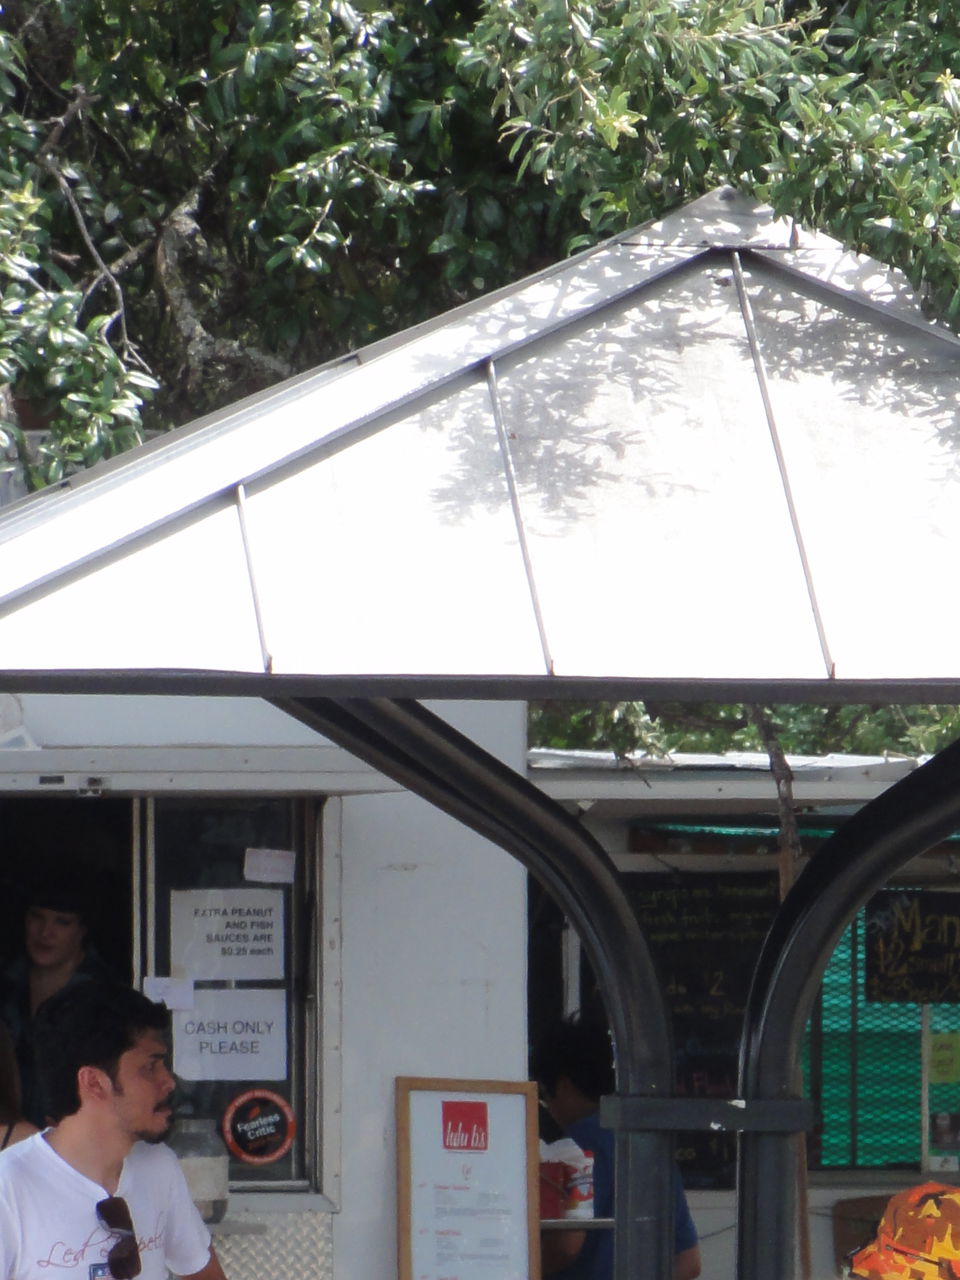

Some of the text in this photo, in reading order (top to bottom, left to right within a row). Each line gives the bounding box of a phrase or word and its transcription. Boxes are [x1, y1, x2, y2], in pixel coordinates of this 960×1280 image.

[193, 908, 274, 917] EXTRA PEANUT
[225, 921, 274, 930] AND FISH
[206, 934, 274, 943] SAUCES ARE
[221, 946, 274, 956] $0.25 each
[185, 1020, 274, 1035] CASH ONLY
[199, 1041, 261, 1054] PLEASE
[237, 1113, 280, 1133] Fearless
[247, 1126, 276, 1140] Critic
[446, 1121, 468, 1147] lulu
[37, 1226, 100, 1269] Led
